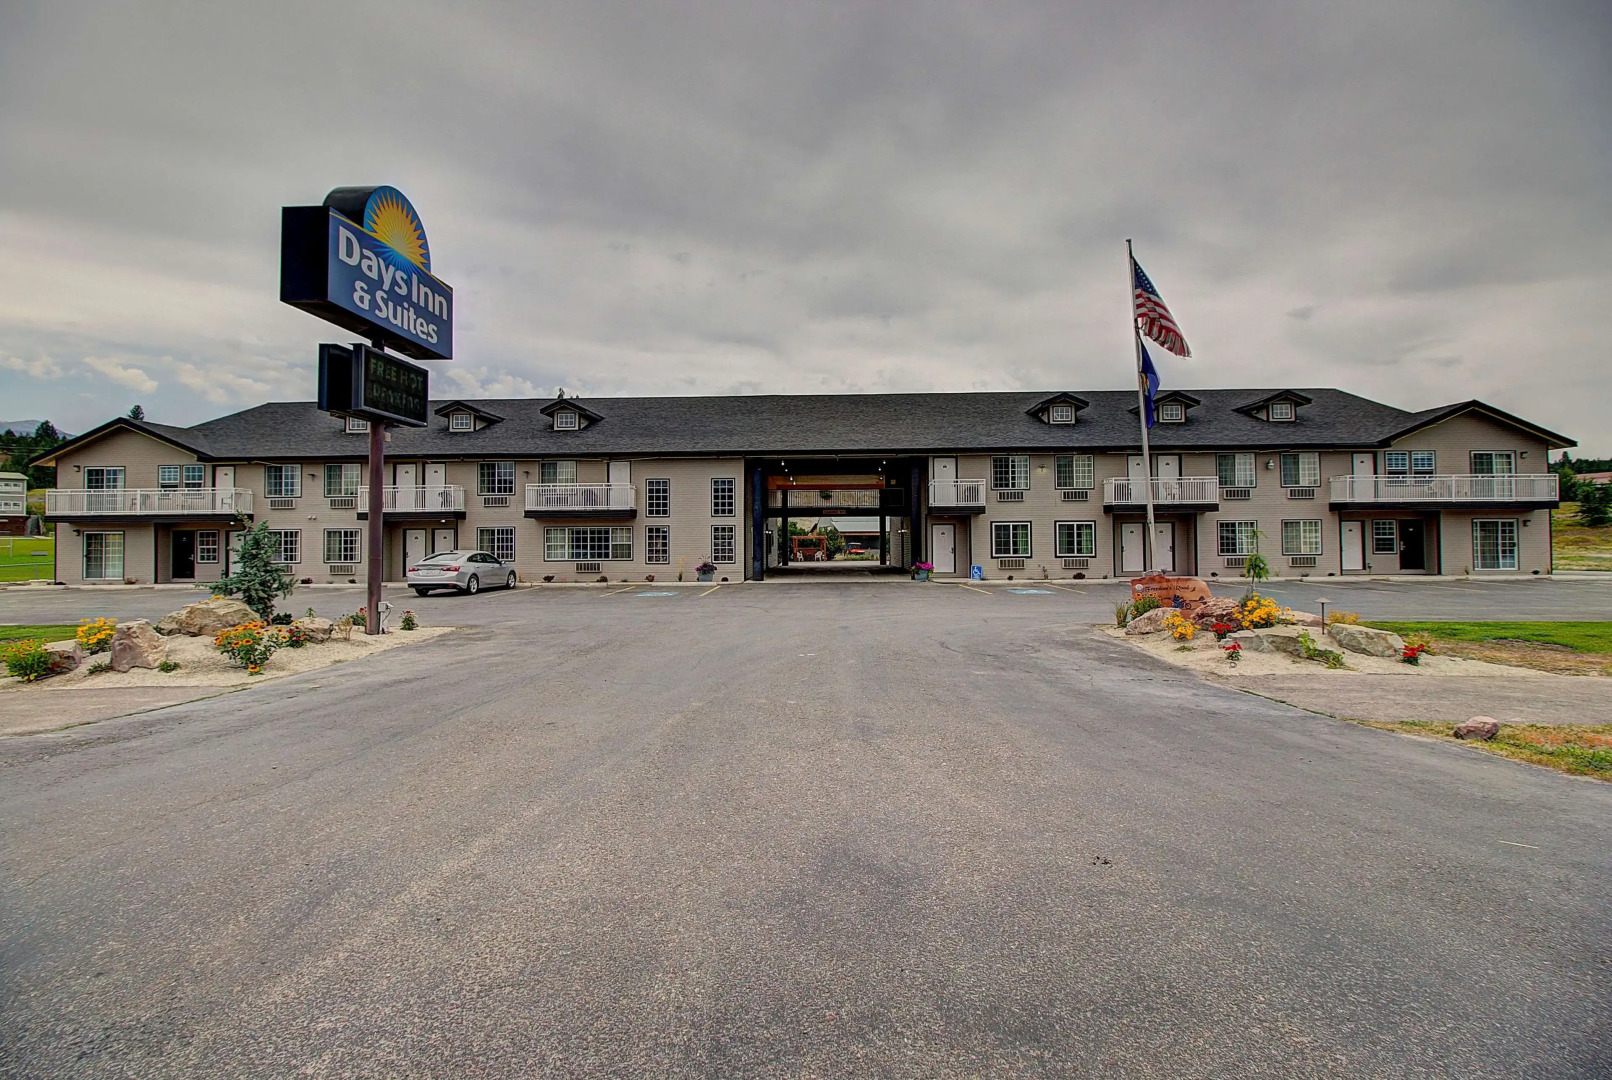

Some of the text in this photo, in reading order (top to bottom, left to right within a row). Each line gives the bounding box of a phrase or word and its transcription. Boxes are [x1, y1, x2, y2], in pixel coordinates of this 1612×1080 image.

[338, 226, 448, 320] Days Inn
[353, 280, 438, 344] & Suites
[370, 358, 397, 382] FREE
